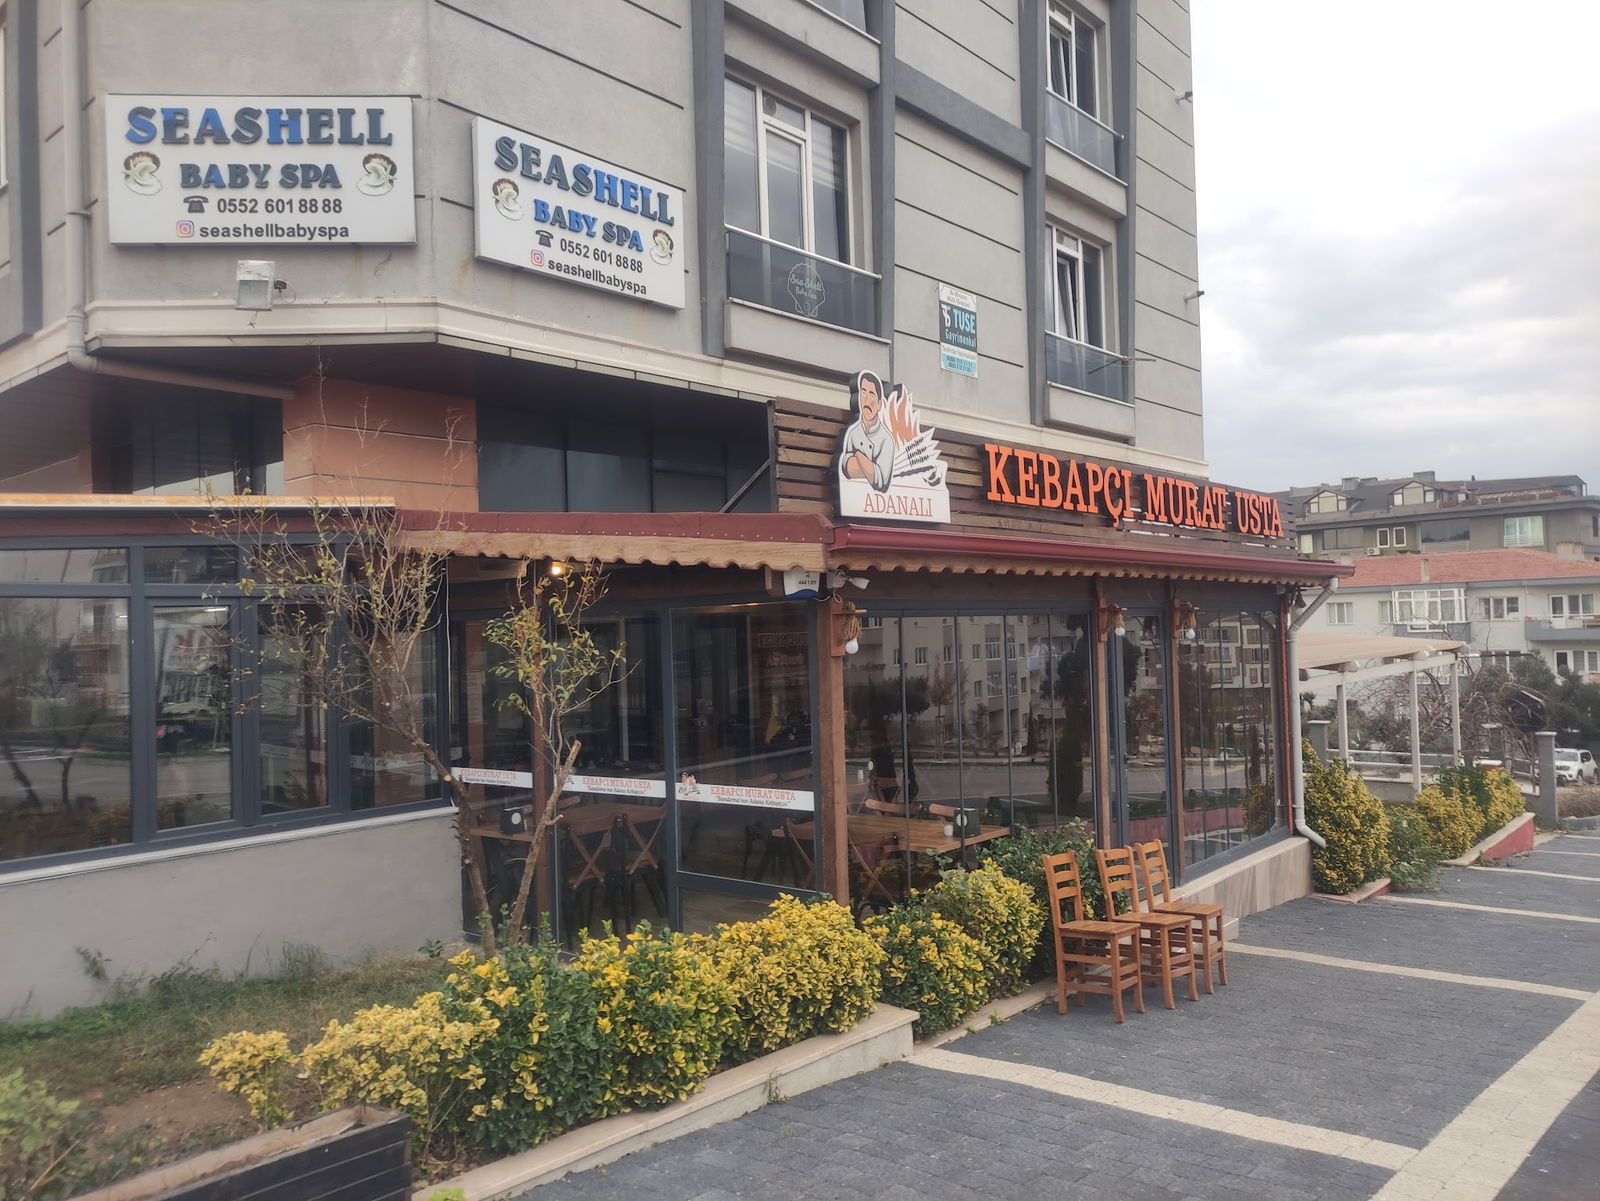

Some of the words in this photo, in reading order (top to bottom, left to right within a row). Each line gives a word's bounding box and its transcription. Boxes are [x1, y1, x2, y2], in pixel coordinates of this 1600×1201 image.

[125, 106, 393, 146] SEASHELL
[180, 163, 271, 188] BABY
[279, 163, 342, 188] SPA
[494, 136, 674, 227] SEASHELL
[217, 199, 258, 213] 0552
[200, 224, 349, 240] seashellbabyspa
[534, 199, 598, 237] BABY
[602, 221, 644, 252] SPA
[560, 238, 590, 258] 0552
[548, 258, 647, 295] seashellbabyspa
[952, 308, 976, 334] TUSE
[983, 442, 1134, 528] KEBAPÇI
[1143, 473, 1227, 531] MURAT
[1234, 491, 1284, 537] USTA
[863, 493, 933, 517] ADANALI
[745, 788, 773, 799] MURAT
[775, 790, 796, 801] USTA
